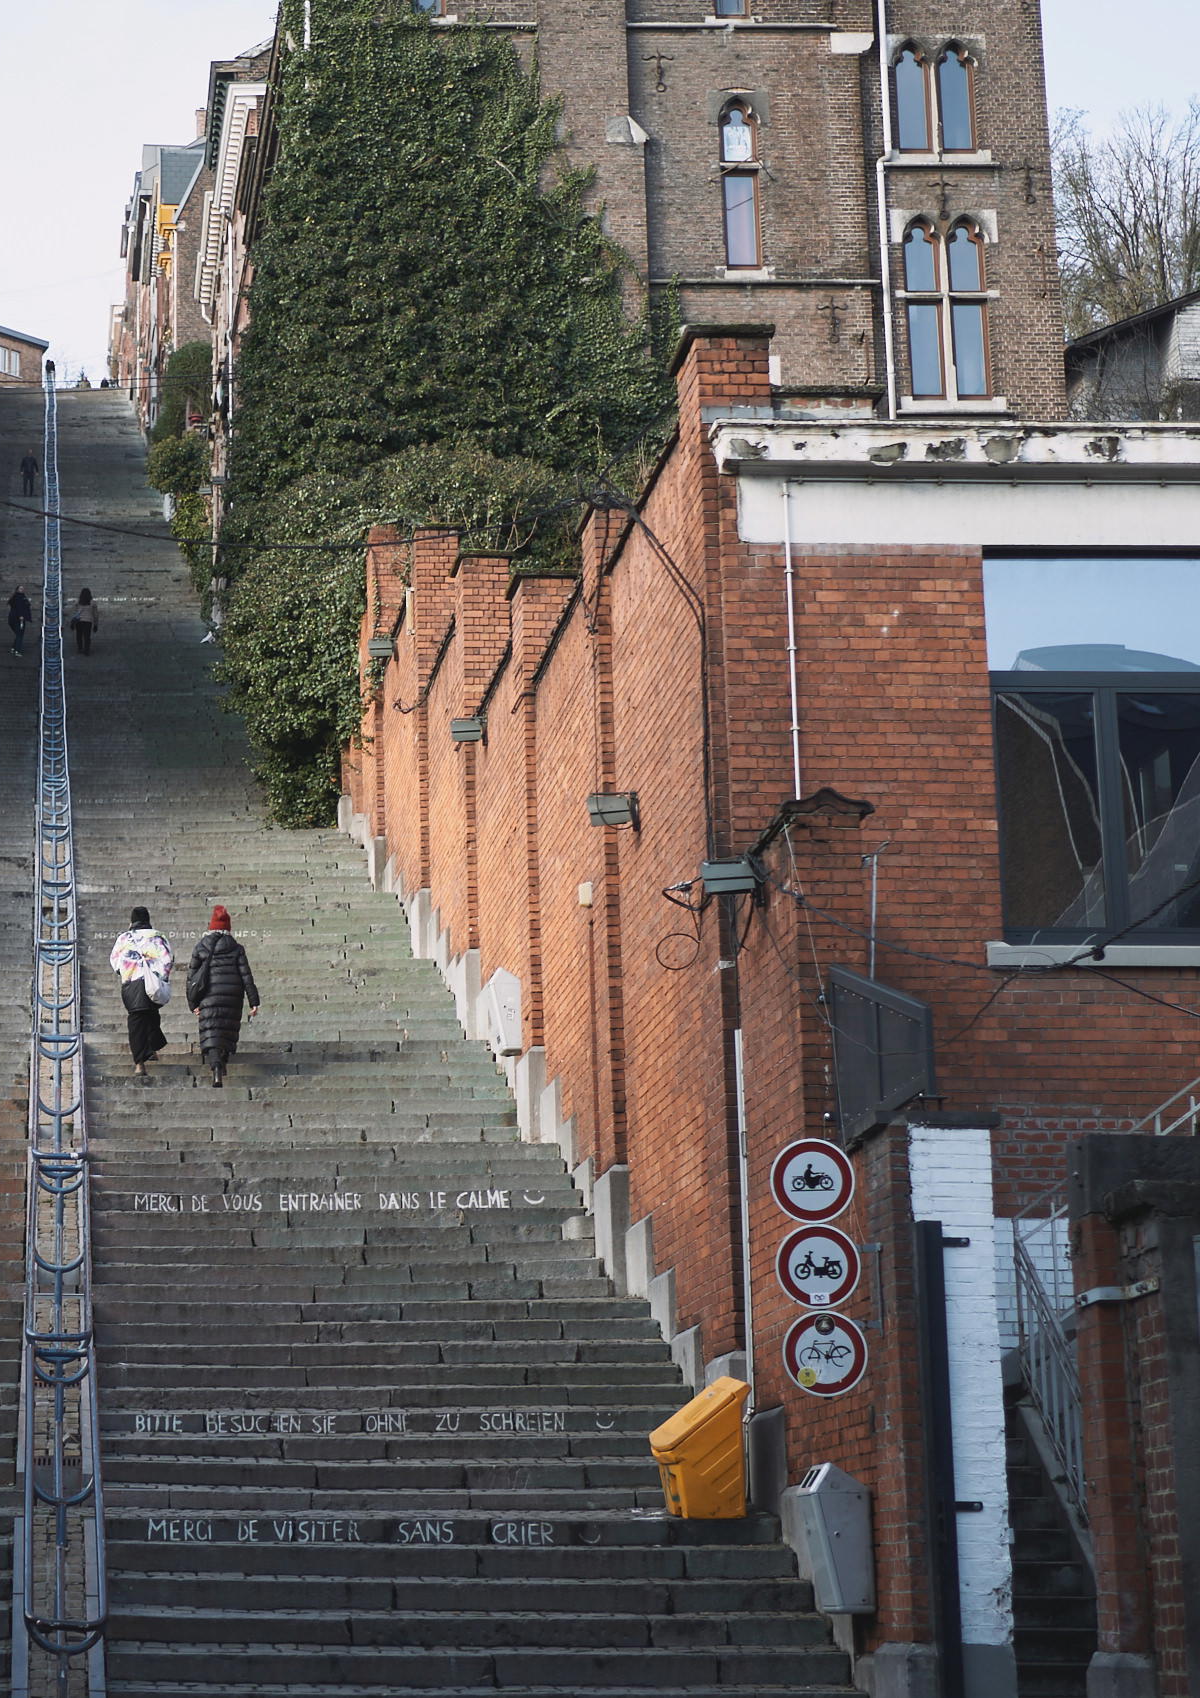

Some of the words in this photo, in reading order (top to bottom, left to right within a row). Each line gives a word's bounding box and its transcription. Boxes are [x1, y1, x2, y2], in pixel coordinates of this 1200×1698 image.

[191, 1195, 210, 1212] DE
[222, 1194, 263, 1212] VOUS
[378, 1192, 420, 1210] DANS
[430, 1192, 447, 1209] LE
[456, 1189, 511, 1209] CALME
[435, 1413, 460, 1432] ZU
[237, 1519, 260, 1542] DE
[397, 1520, 455, 1544] SANS
